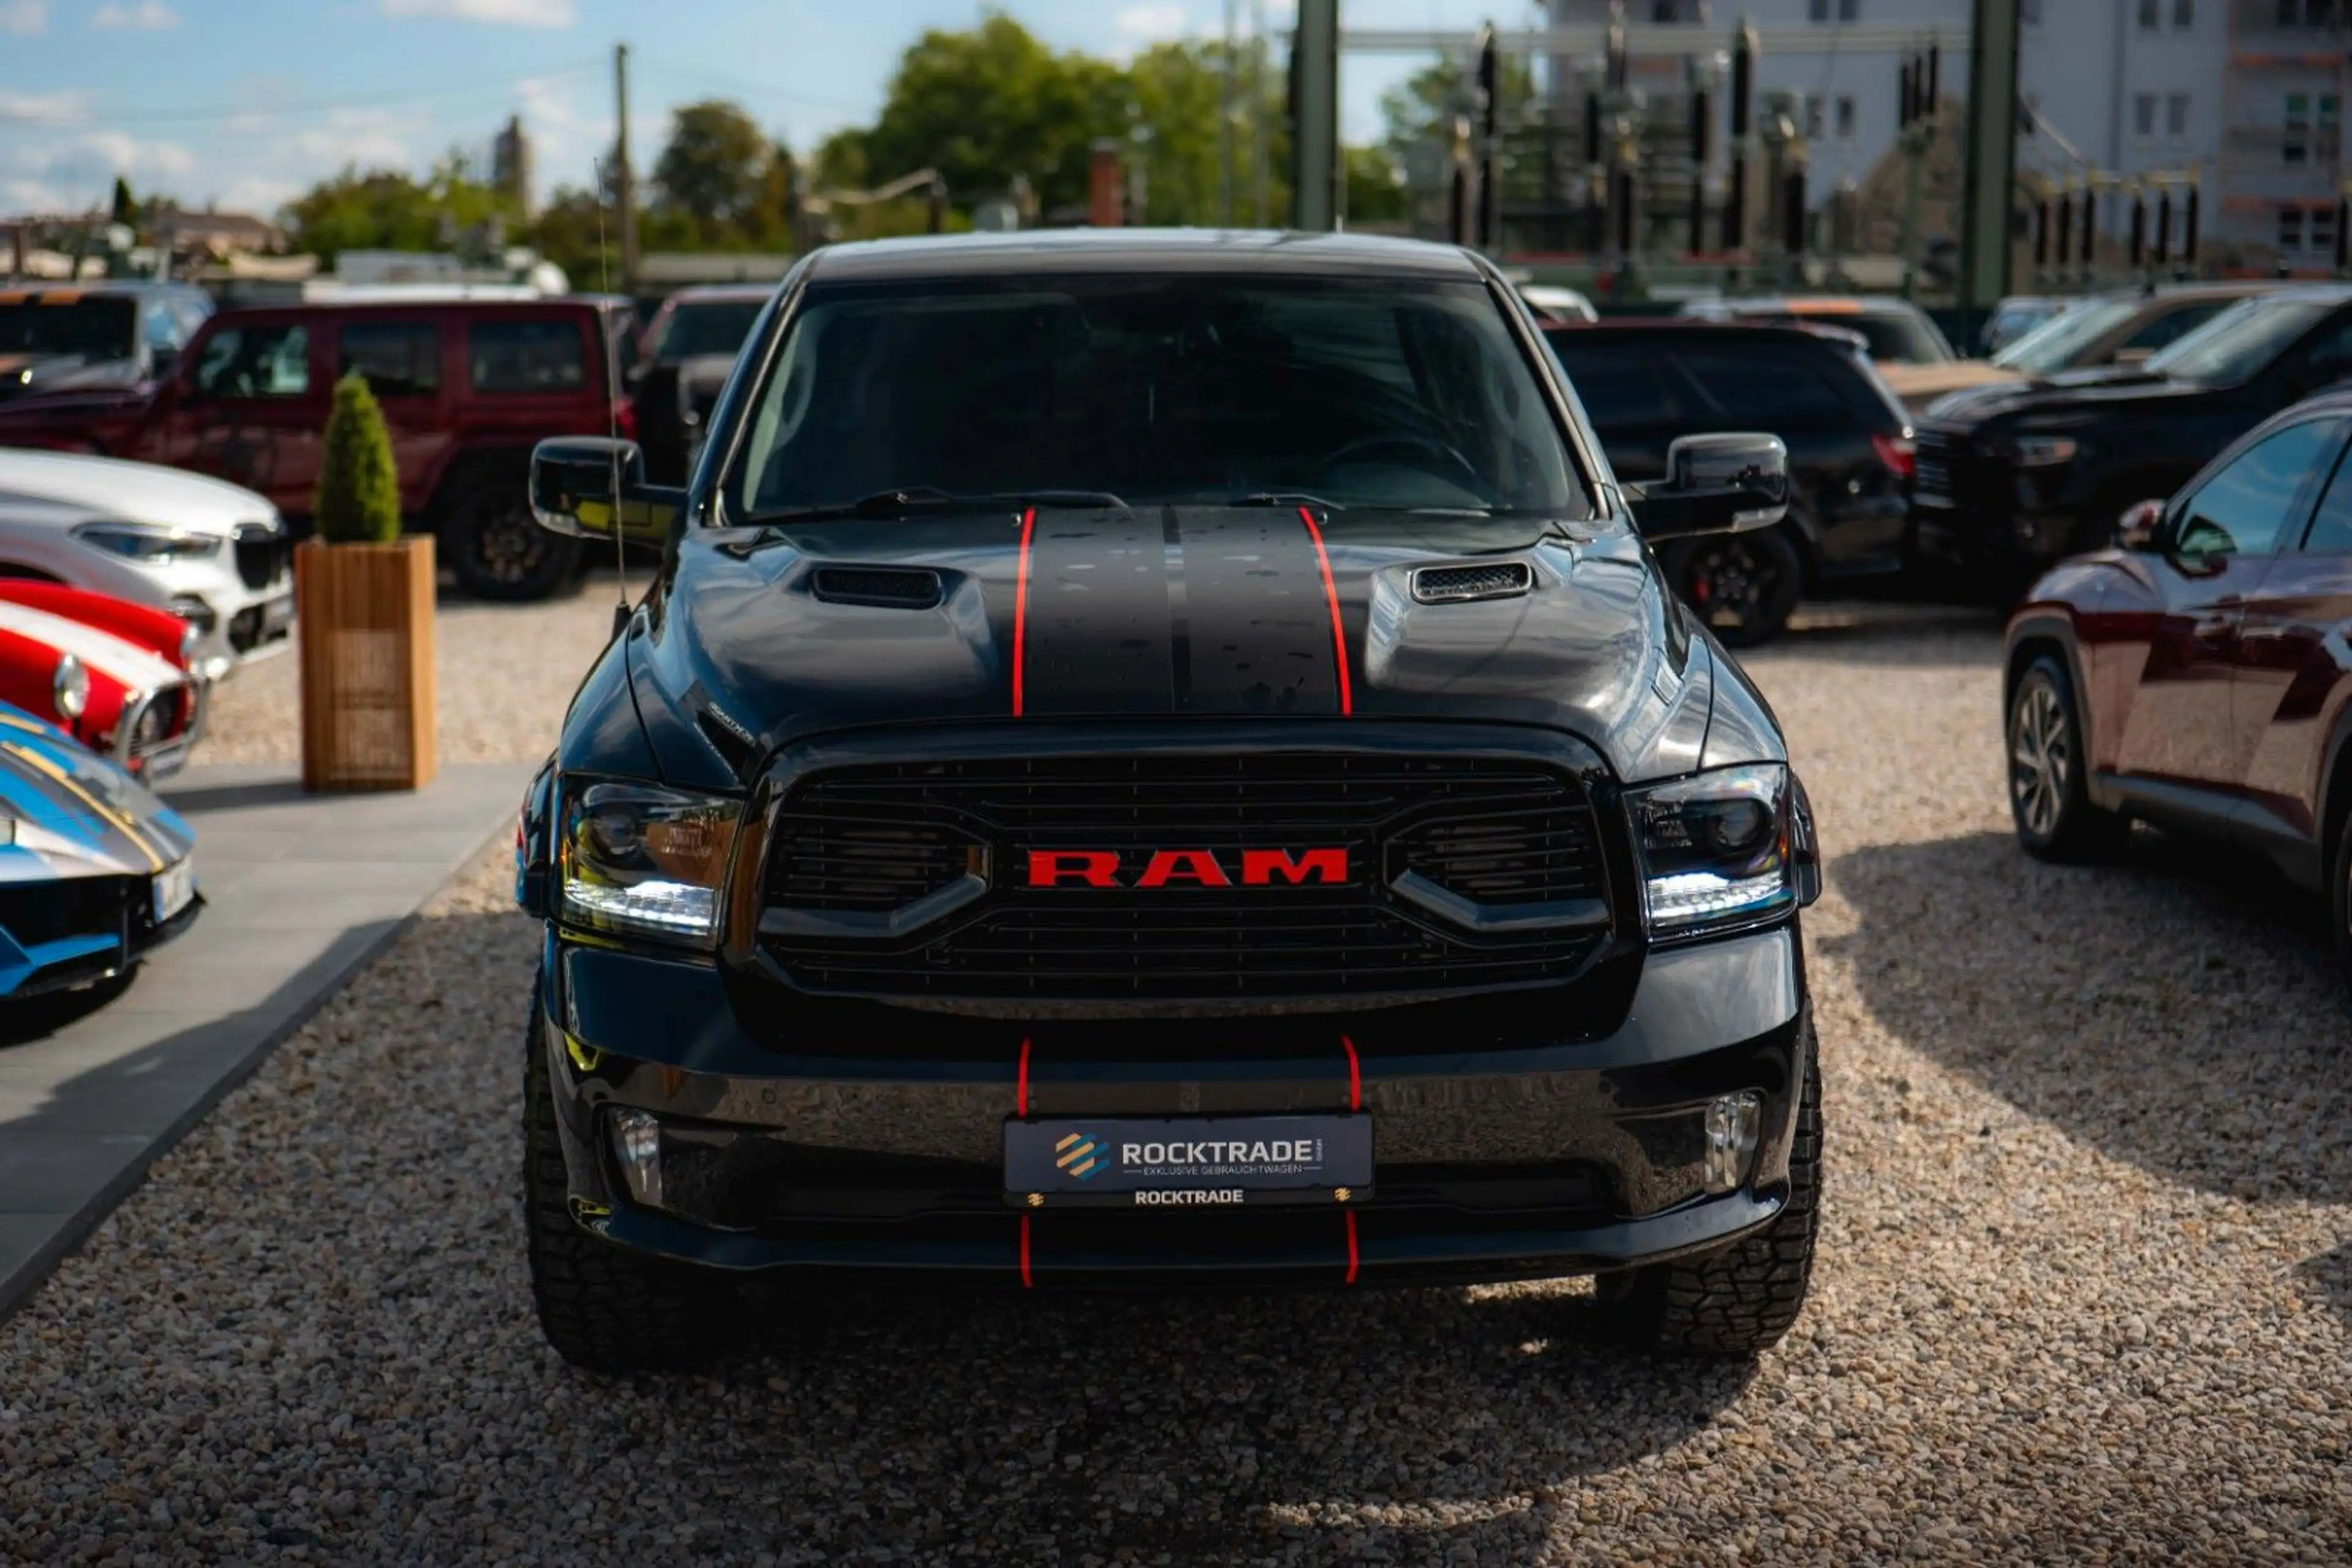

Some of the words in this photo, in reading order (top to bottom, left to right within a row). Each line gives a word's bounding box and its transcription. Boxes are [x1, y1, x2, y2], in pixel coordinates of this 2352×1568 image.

[1028, 848, 1348, 887] RAM
[1123, 1140, 1313, 1164] ROCKTRADE
[1135, 1189, 1244, 1205] ROCKTRADE
